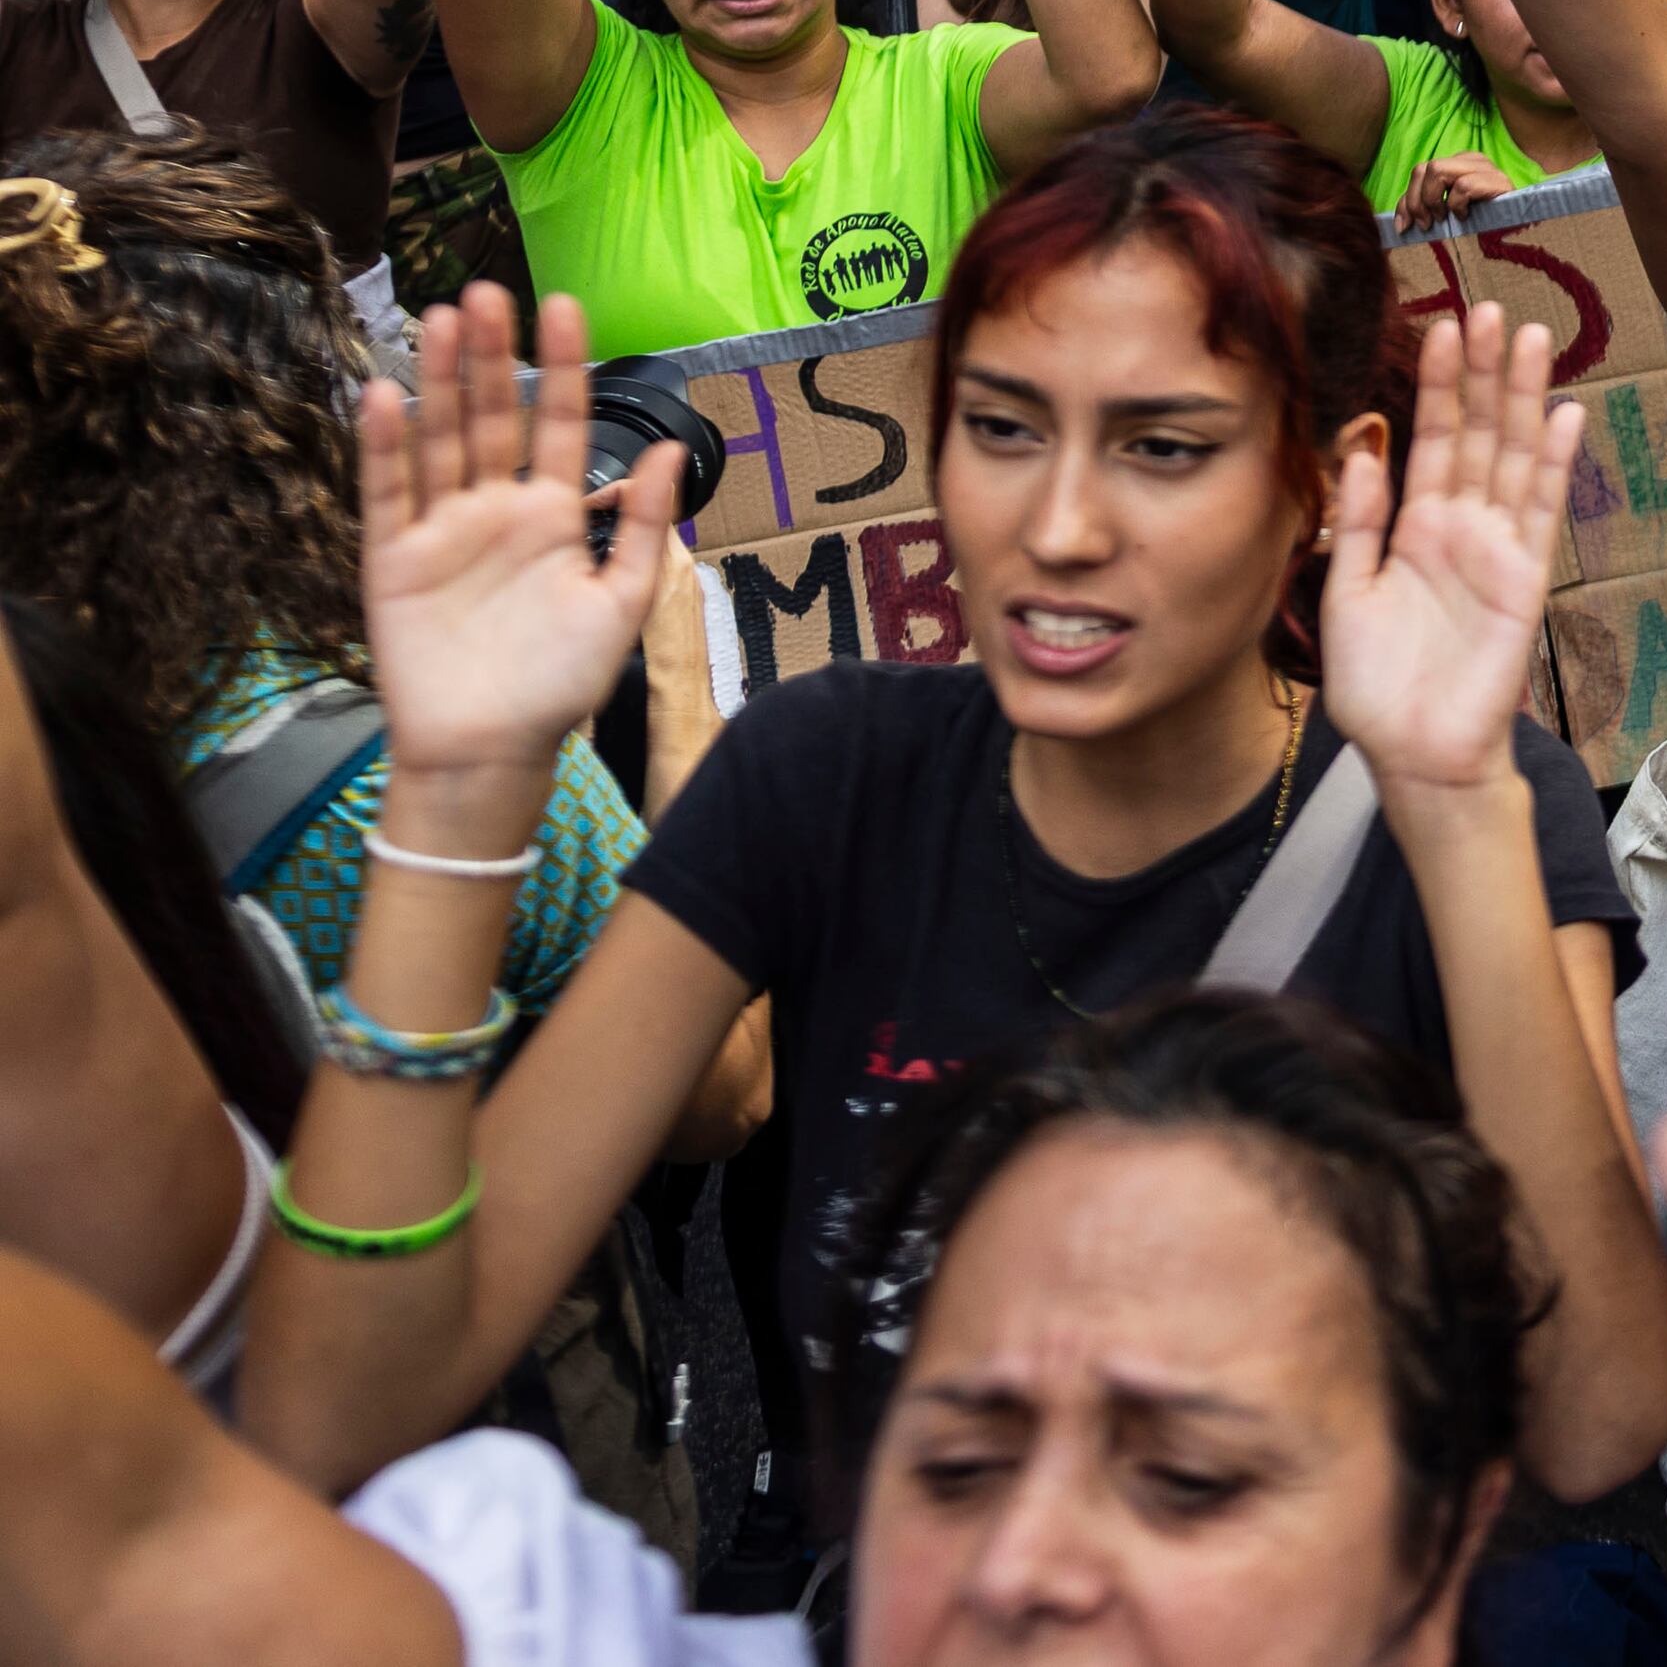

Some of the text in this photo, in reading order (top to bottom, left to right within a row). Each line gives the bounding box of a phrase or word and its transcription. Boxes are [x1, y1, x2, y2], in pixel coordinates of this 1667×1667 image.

[825, 214, 879, 243] Apoyo
[805, 238, 825, 259] de
[802, 261, 819, 296] Red
